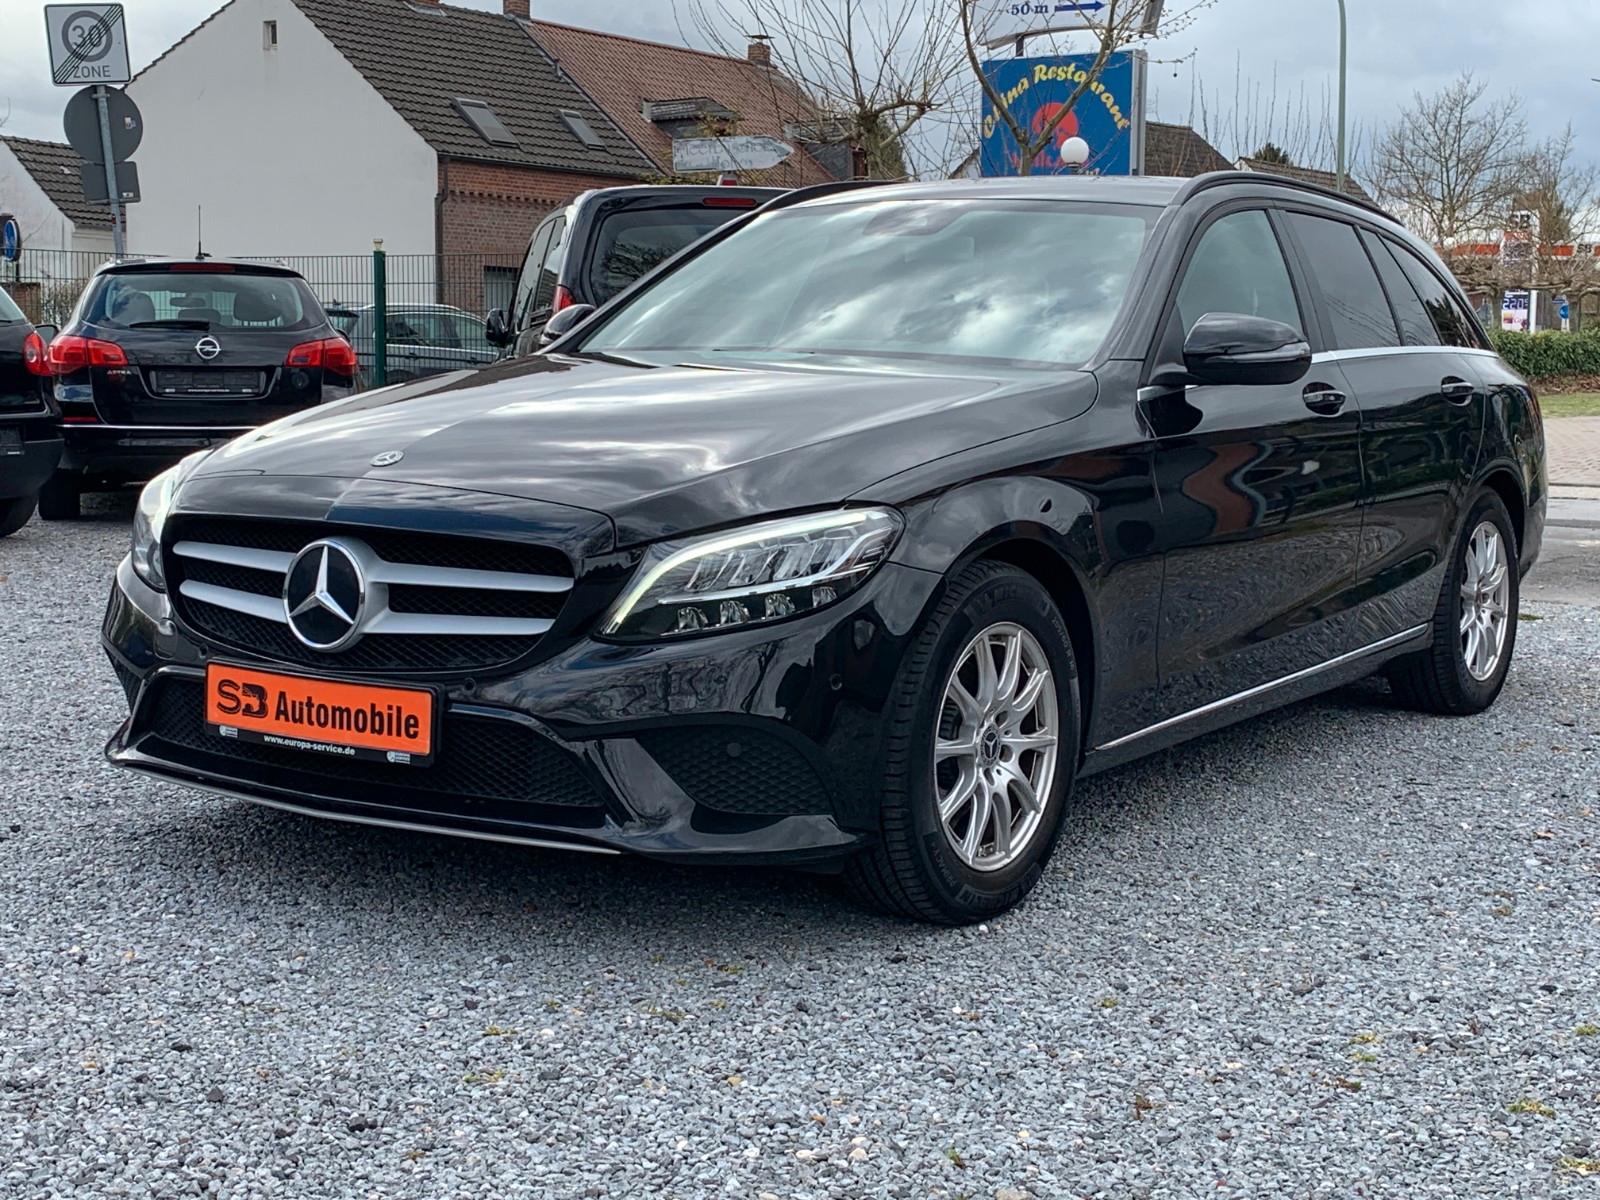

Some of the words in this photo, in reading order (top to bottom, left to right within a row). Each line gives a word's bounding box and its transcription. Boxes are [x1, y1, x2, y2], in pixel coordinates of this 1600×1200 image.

[1011, 4, 1030, 15] 50
[1034, 5, 1048, 14] m
[72, 25, 103, 48] 30
[73, 65, 112, 79] ZONE
[216, 679, 269, 719] SB
[274, 690, 419, 740] Automobile
[263, 734, 356, 756] www.europa-service.de
